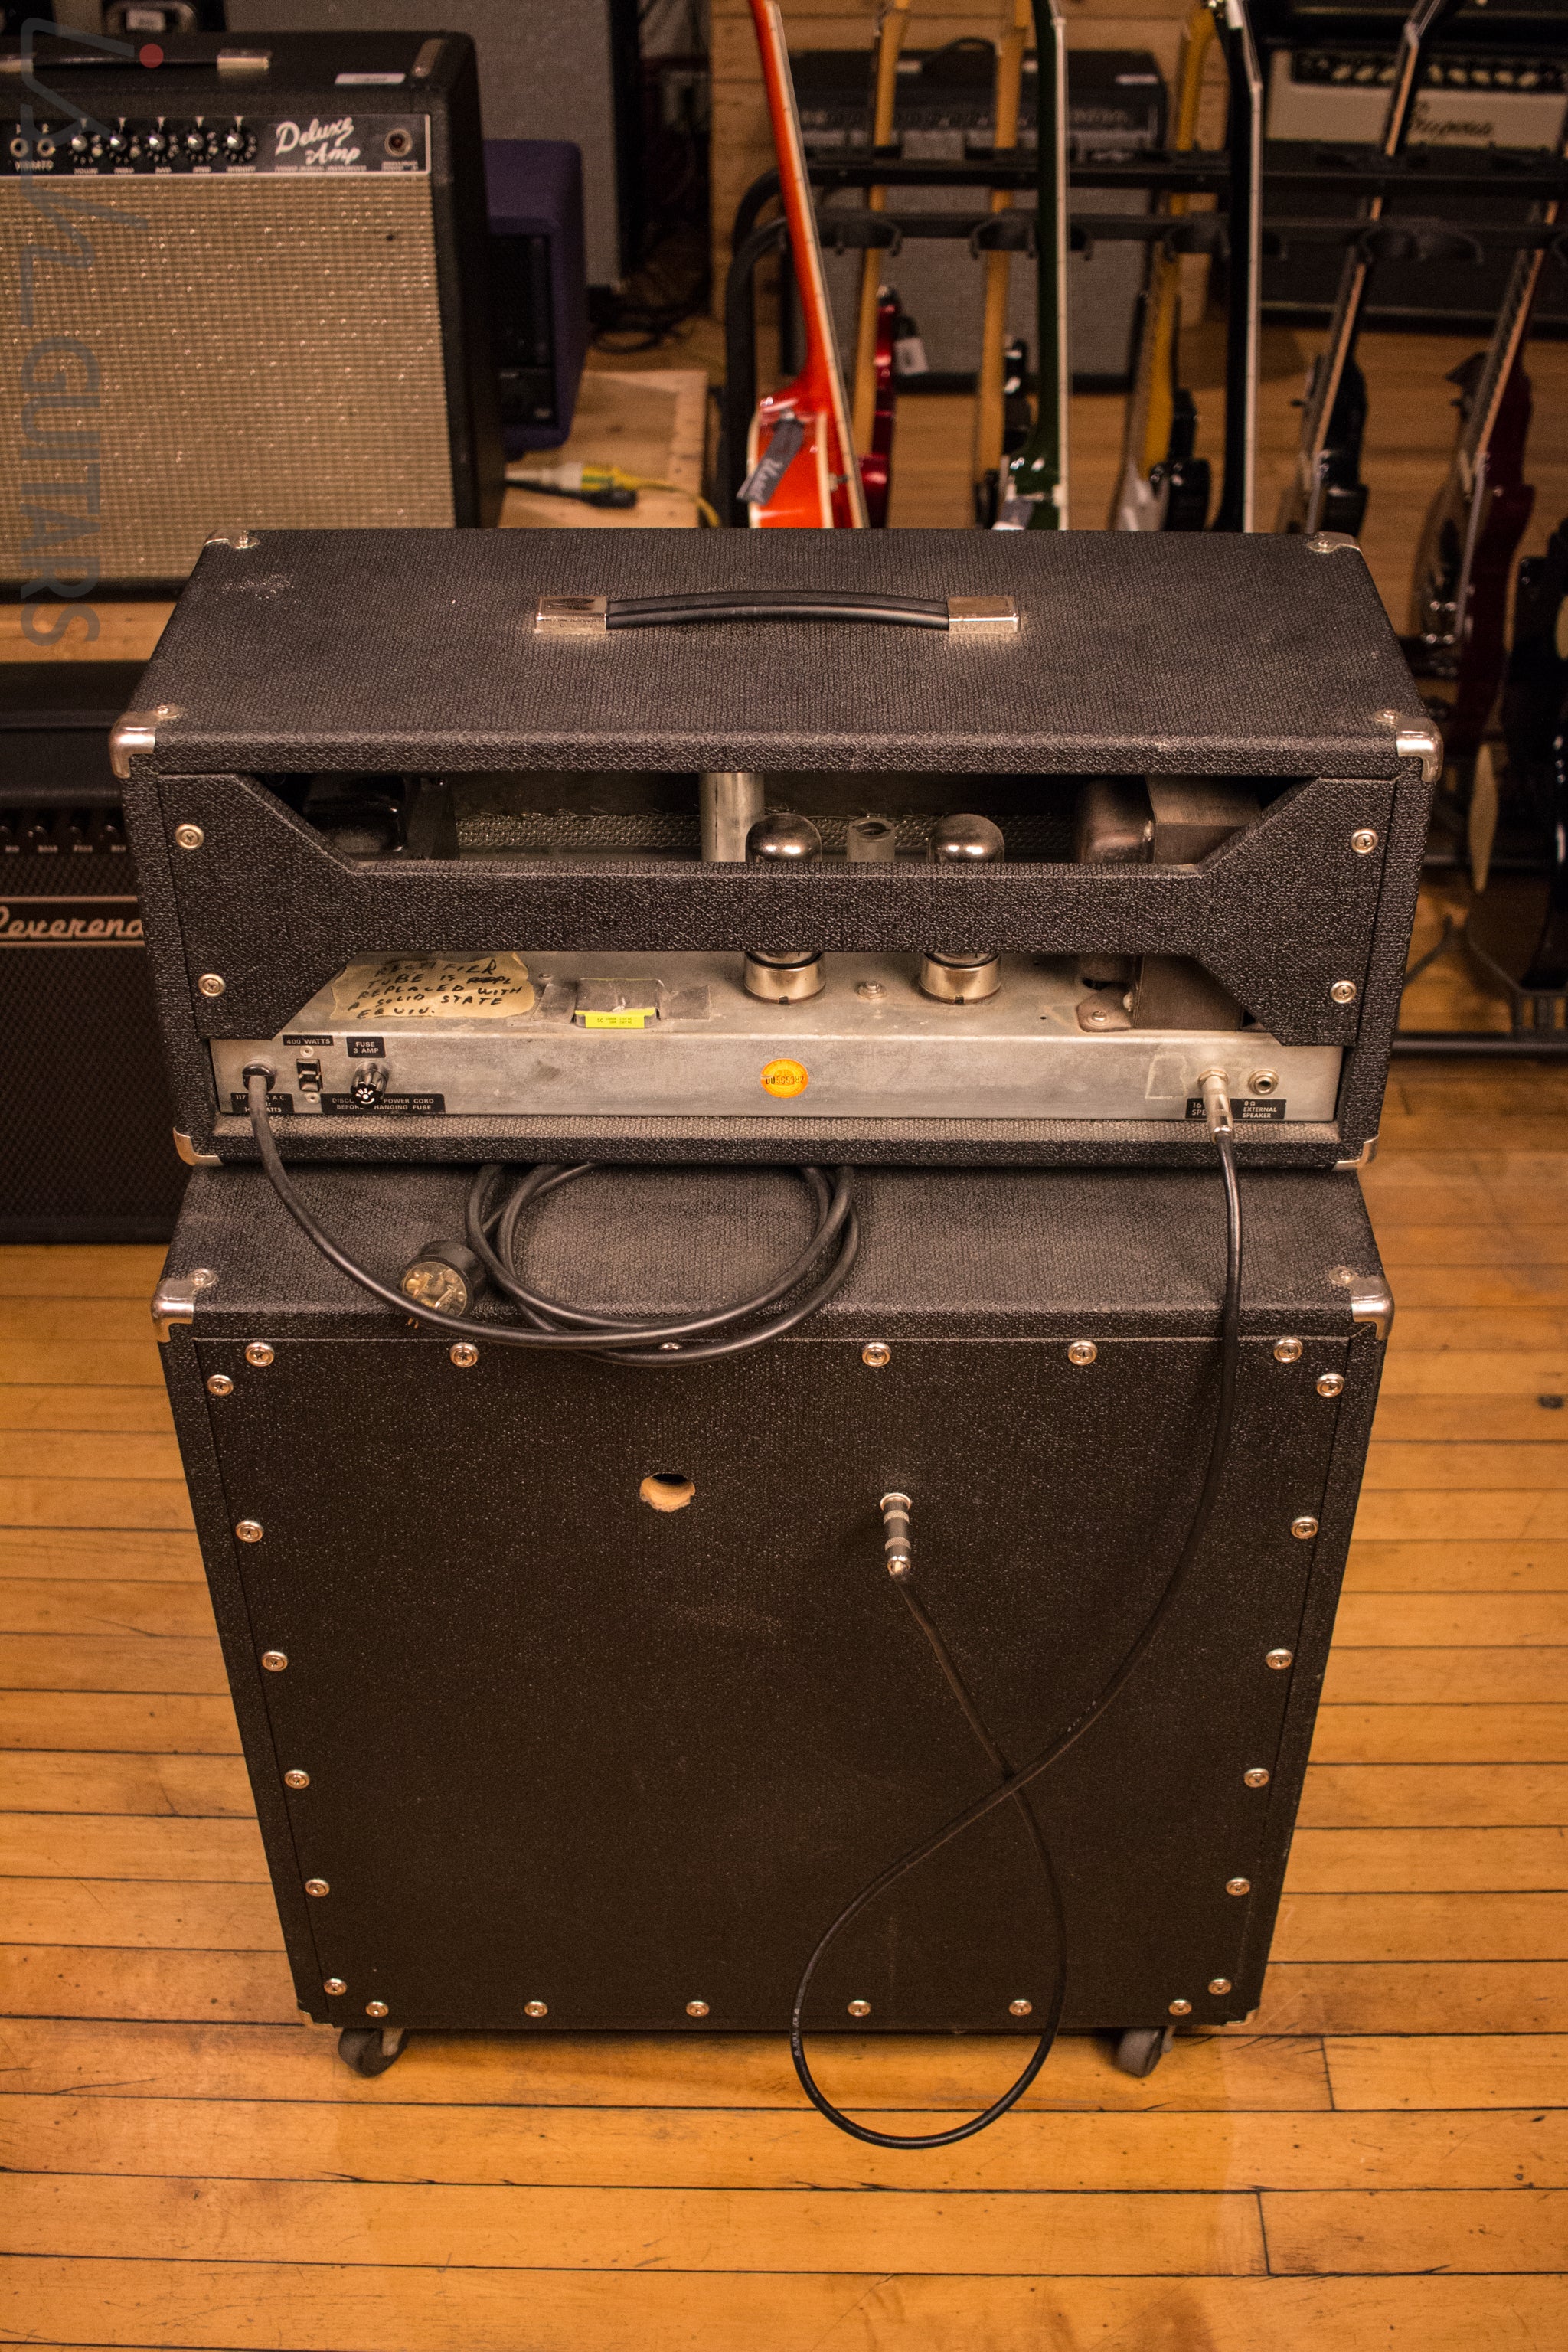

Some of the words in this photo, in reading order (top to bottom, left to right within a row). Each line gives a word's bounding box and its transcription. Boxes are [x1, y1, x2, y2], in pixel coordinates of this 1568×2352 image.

[276, 116, 354, 156] Deluxe
[305, 142, 361, 165] Amp
[374, 959, 497, 977] RECTIFIER
[368, 974, 423, 988] TUBE
[357, 985, 464, 999] REPLACED
[477, 986, 522, 996] WITH
[348, 1002, 360, 1011] A
[376, 994, 425, 1008] SOLID
[441, 995, 503, 1005] STATE
